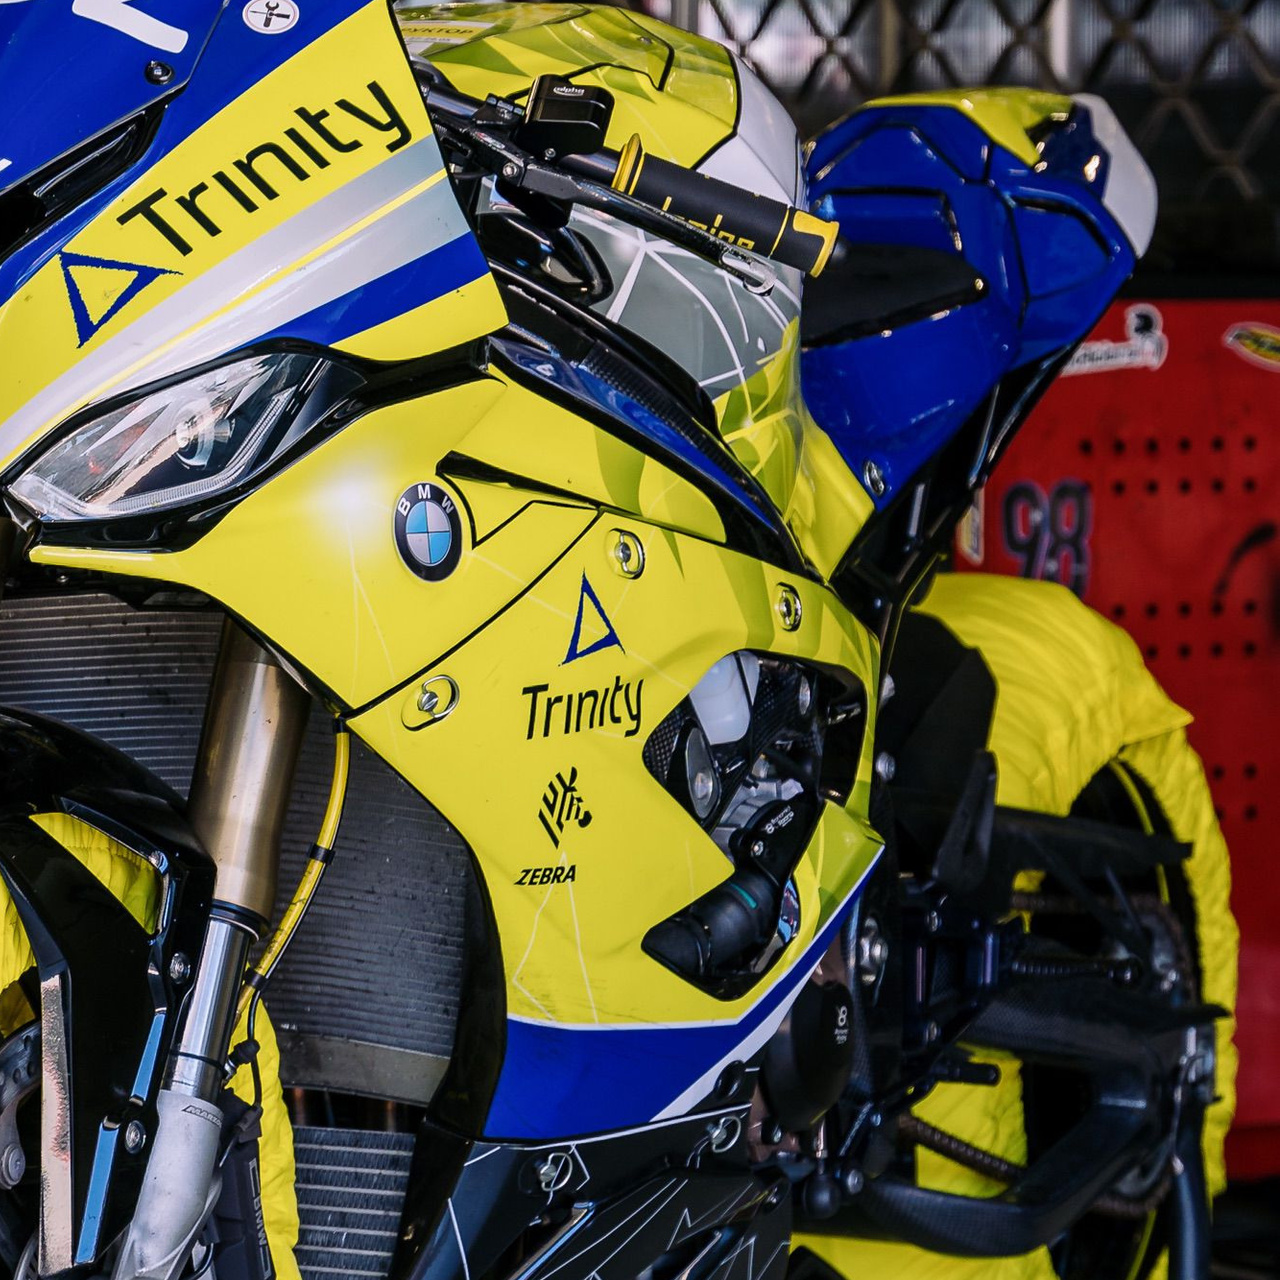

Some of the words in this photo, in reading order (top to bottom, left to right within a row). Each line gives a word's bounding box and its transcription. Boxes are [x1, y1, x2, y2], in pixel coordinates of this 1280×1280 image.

[116, 80, 412, 257] Trinity
[397, 484, 454, 517] BMW
[1002, 478, 1094, 598] 98
[522, 675, 644, 740] Trinity
[514, 864, 577, 885] ZEBRA
[253, 1197, 268, 1246] BMW
